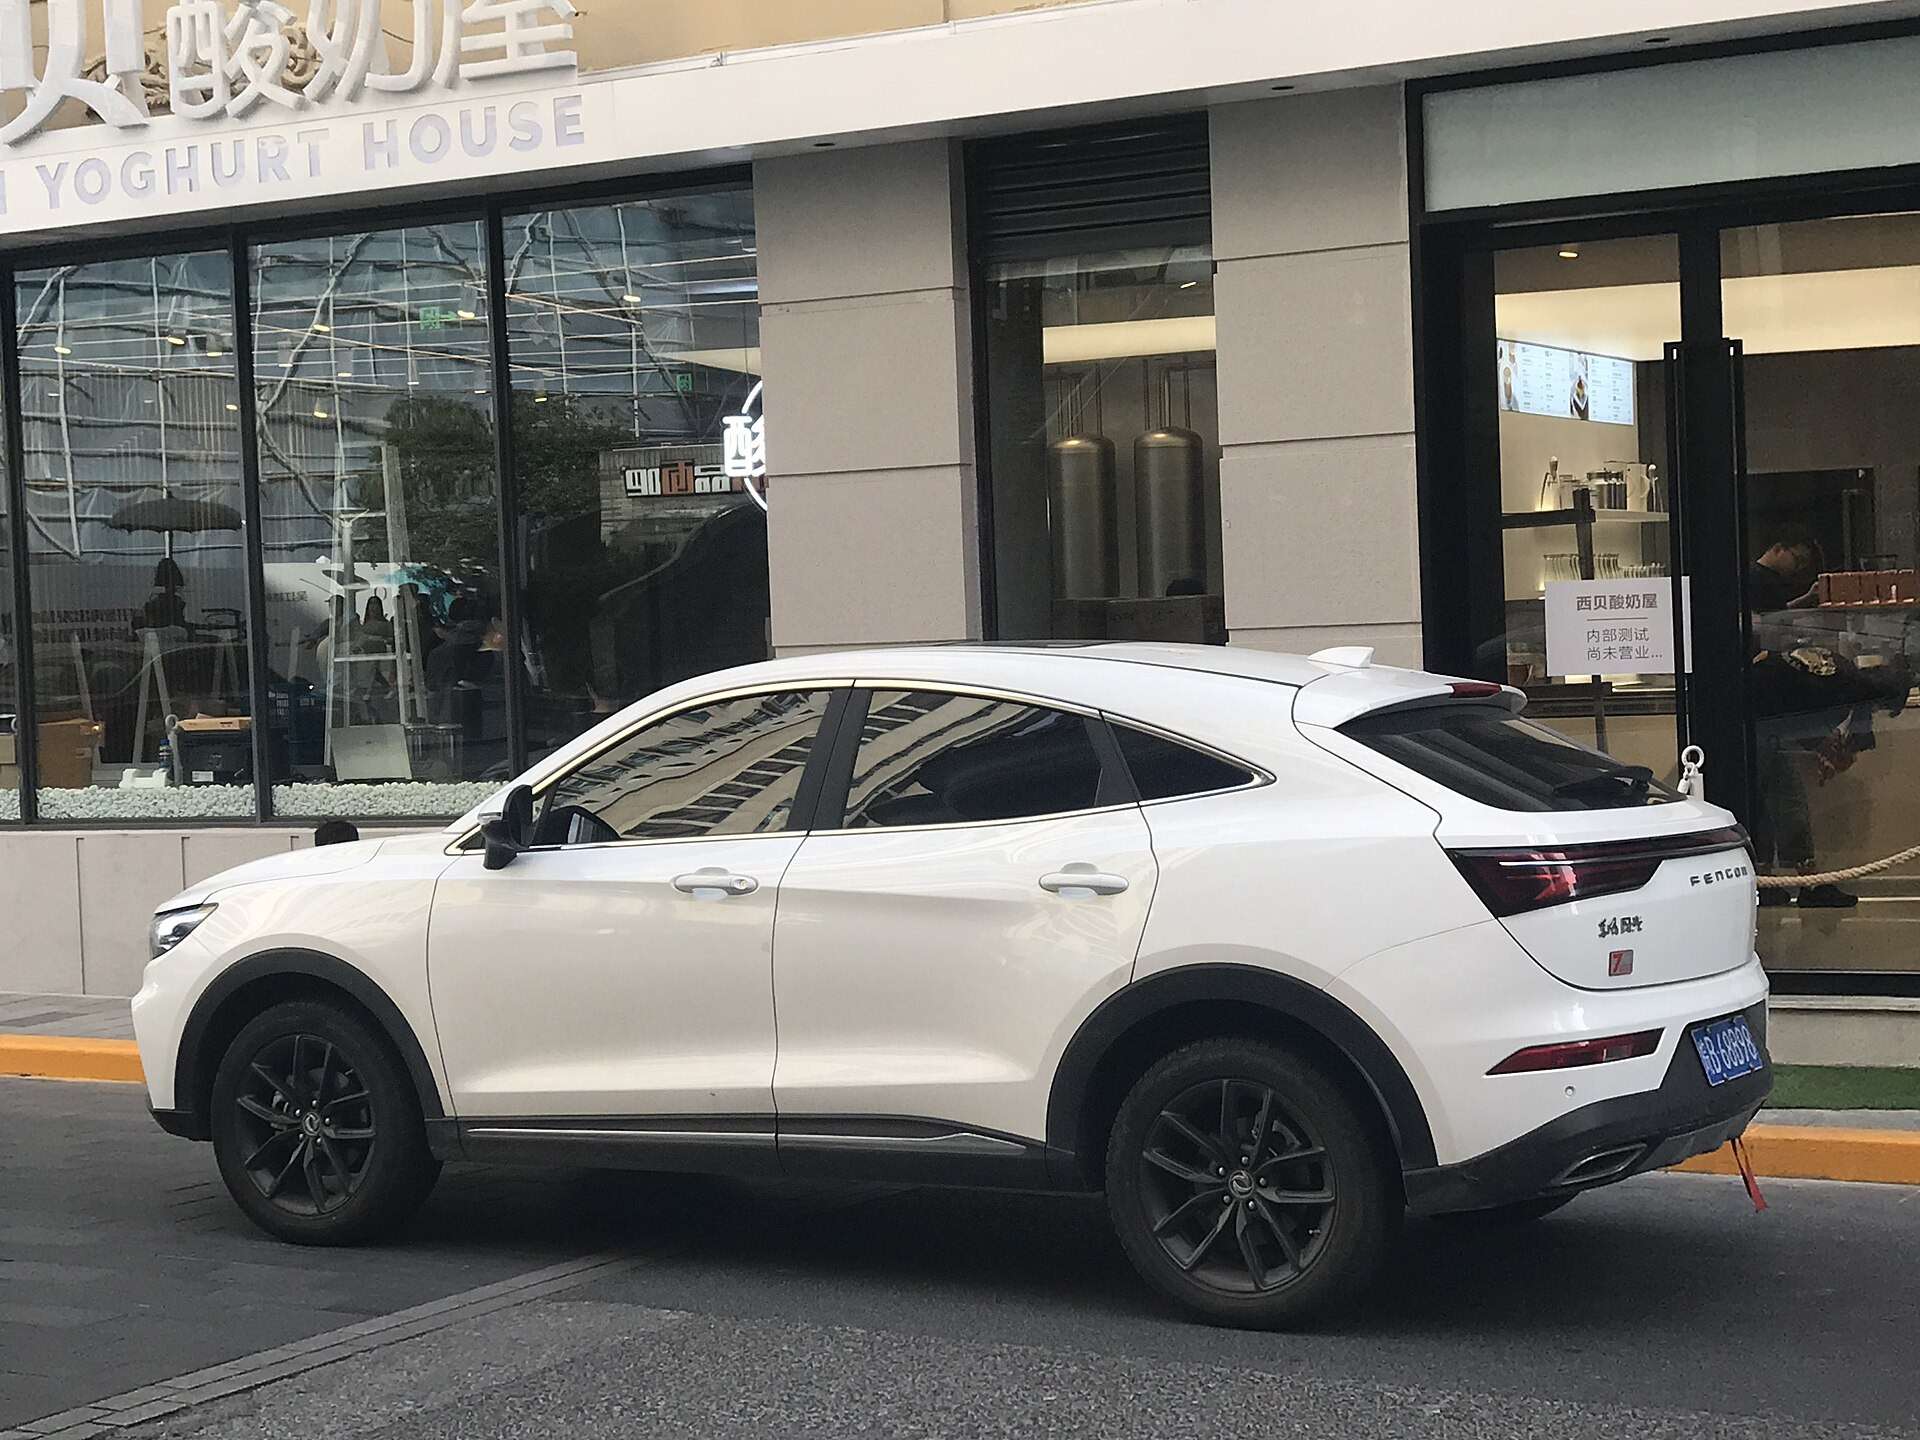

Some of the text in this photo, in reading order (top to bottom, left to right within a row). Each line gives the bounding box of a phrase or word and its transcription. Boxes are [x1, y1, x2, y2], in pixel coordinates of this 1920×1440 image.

[36, 128, 330, 209] YOGHURT
[363, 95, 585, 172] HOUSE
[1576, 593, 1658, 611] 西贝酸奶屋
[1586, 627, 1650, 643] 内部测试
